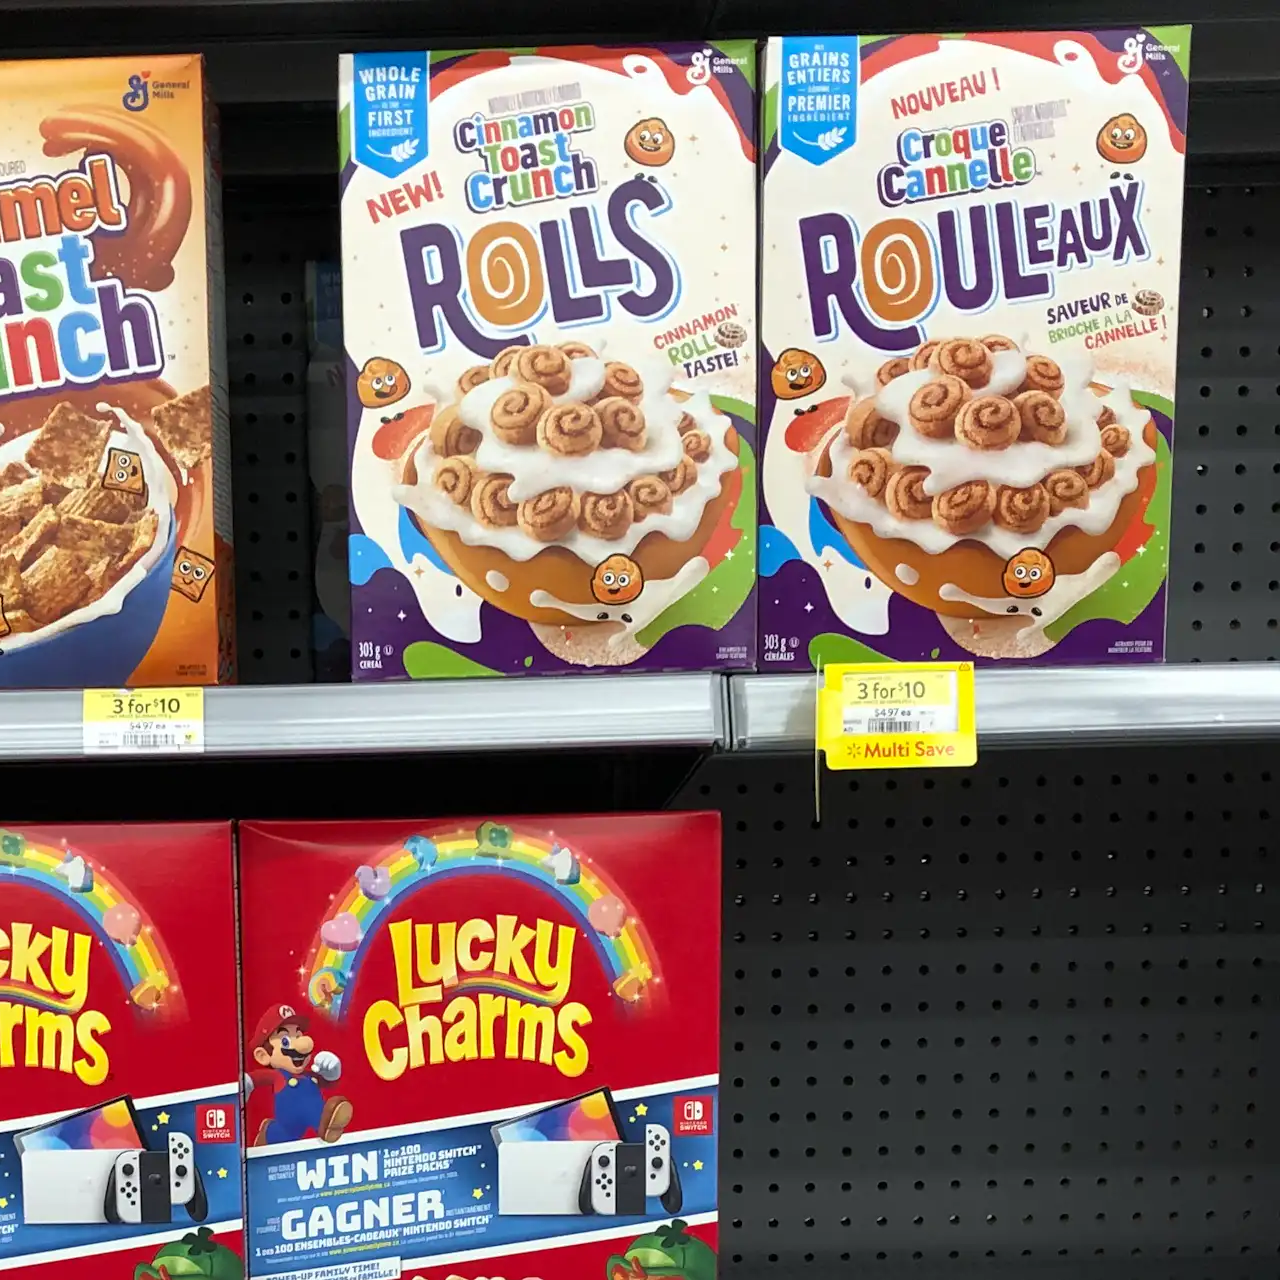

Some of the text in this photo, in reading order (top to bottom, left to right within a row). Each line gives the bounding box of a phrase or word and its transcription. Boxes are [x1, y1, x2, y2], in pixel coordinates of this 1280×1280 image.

[790, 52, 849, 68] GRAINS
[359, 68, 420, 85] WHOLE
[788, 69, 851, 85] ENTIERS
[366, 86, 416, 101] GRAIN
[788, 94, 851, 111] PREMIER
[891, 71, 988, 119] NOUVEAU
[369, 110, 413, 126] FIRST
[458, 105, 592, 149] Cinnamon
[485, 132, 569, 174] Toast
[903, 122, 1006, 162] Croque
[468, 154, 595, 210] Crunch
[883, 148, 1033, 201] Cannelle
[367, 171, 444, 224] NEW!
[400, 178, 676, 360] ROLLS
[799, 182, 1145, 351] ROULEAUX
[1048, 292, 1128, 324] SAVEUR DE
[654, 304, 738, 349] CINNAMON
[1048, 310, 1132, 343] BRIOCHE LA
[1085, 318, 1158, 349] CANNELLE
[669, 340, 716, 366] ROLL
[684, 351, 739, 379] TASTE!
[764, 634, 778, 649] 303
[858, 681, 925, 699] 3 for $10
[113, 698, 180, 714] 3 for $10
[865, 741, 955, 758] Multi Save
[388, 914, 576, 1007] Lucky
[363, 993, 592, 1081] Charms
[297, 1151, 378, 1191] WIN
[384, 1153, 436, 1169] NINTENDO
[384, 1162, 413, 1178] PRIZE
[282, 1189, 445, 1241] GAGNER
[315, 1266, 350, 1279] FAMILY
[352, 1262, 380, 1273] TIME!
